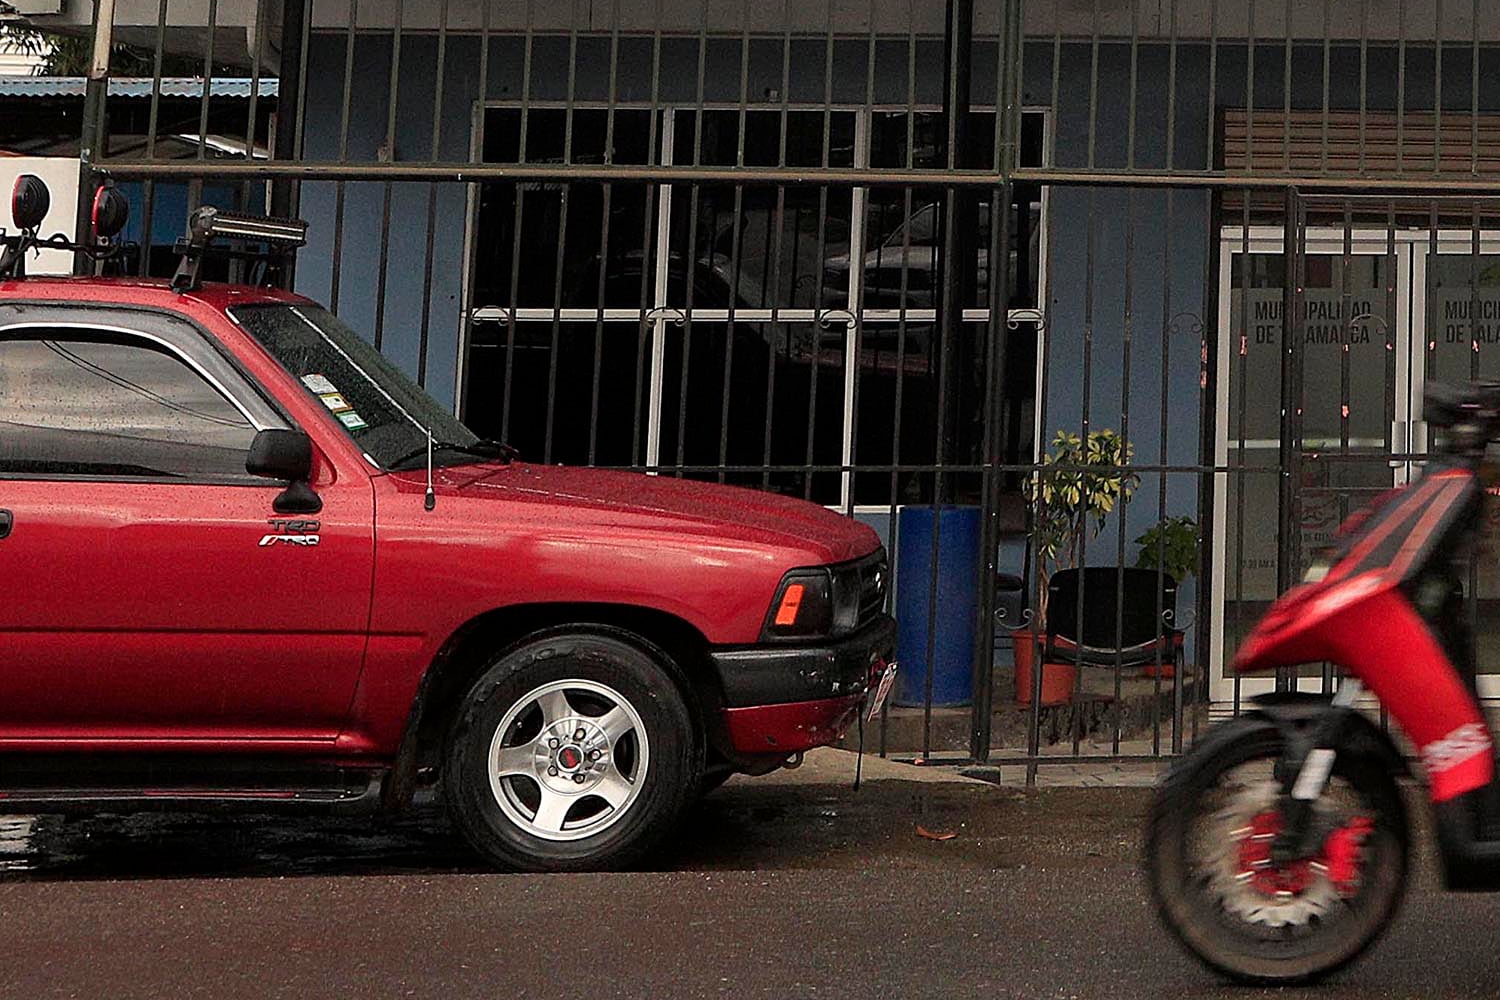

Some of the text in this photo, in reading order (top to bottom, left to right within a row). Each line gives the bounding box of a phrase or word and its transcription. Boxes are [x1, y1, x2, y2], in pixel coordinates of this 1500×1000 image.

[1256, 325, 1275, 344] DE
[1446, 324, 1464, 343] DE
[268, 519, 321, 534] TRD
